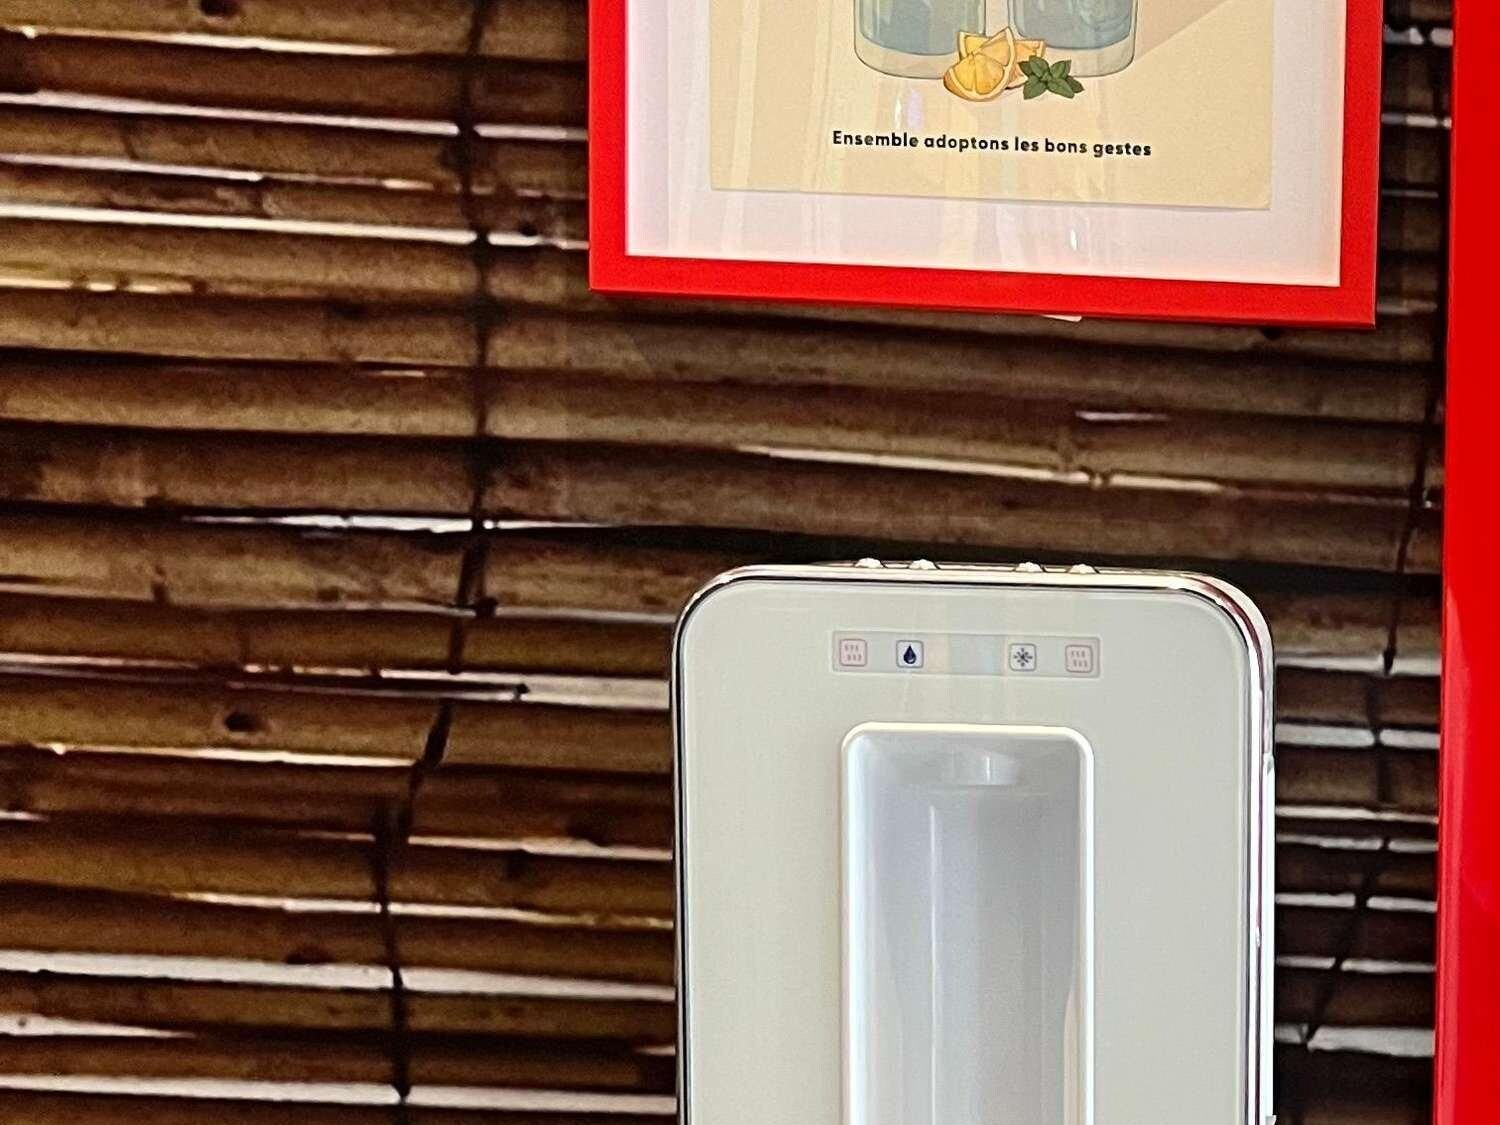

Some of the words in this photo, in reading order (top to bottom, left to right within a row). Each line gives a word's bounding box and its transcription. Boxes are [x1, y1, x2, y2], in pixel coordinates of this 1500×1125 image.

[832, 130, 919, 147] Ensemble
[923, 134, 1010, 152] adoptons
[1014, 136, 1038, 152] les
[1044, 138, 1088, 154] bons
[1093, 142, 1152, 158] gestes
